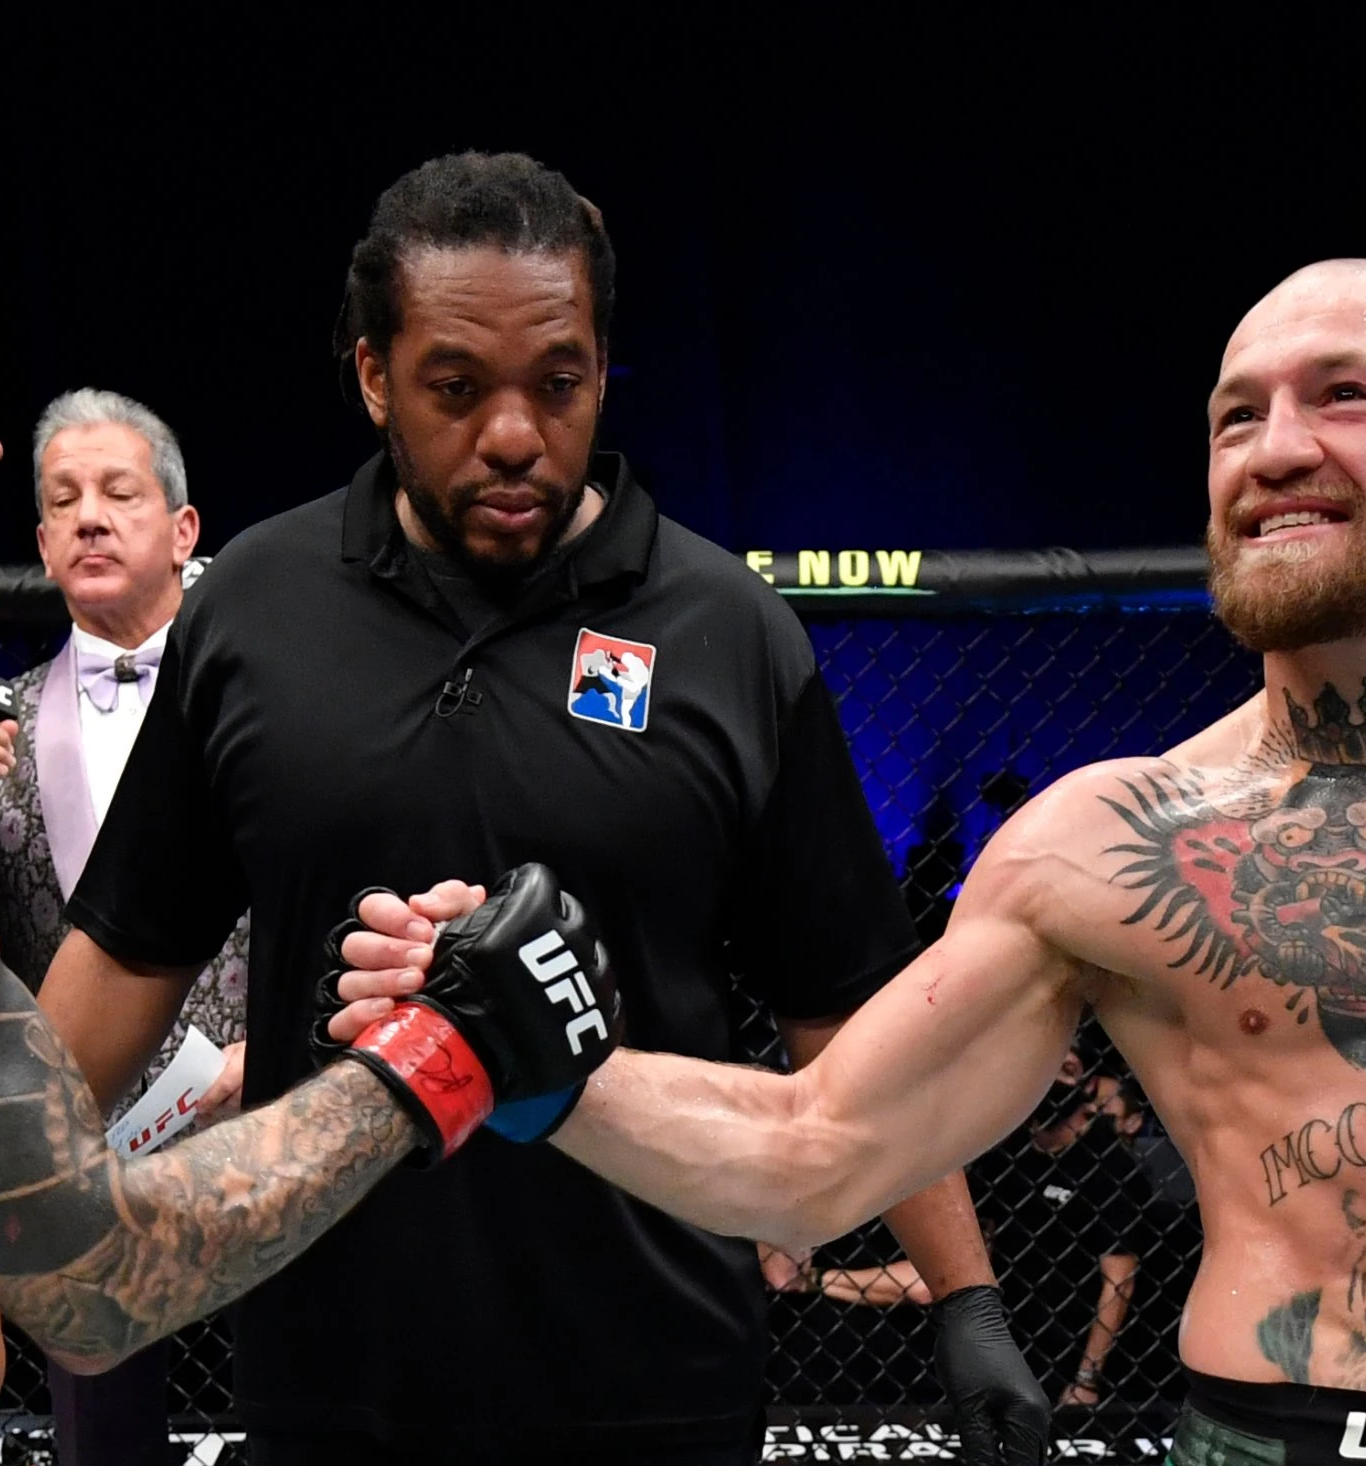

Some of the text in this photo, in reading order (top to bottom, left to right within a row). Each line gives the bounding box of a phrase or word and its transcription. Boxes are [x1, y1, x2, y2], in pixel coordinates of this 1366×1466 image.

[798, 550, 922, 586] NOW
[518, 929, 608, 1056] UFC
[129, 1087, 198, 1152] UFC
